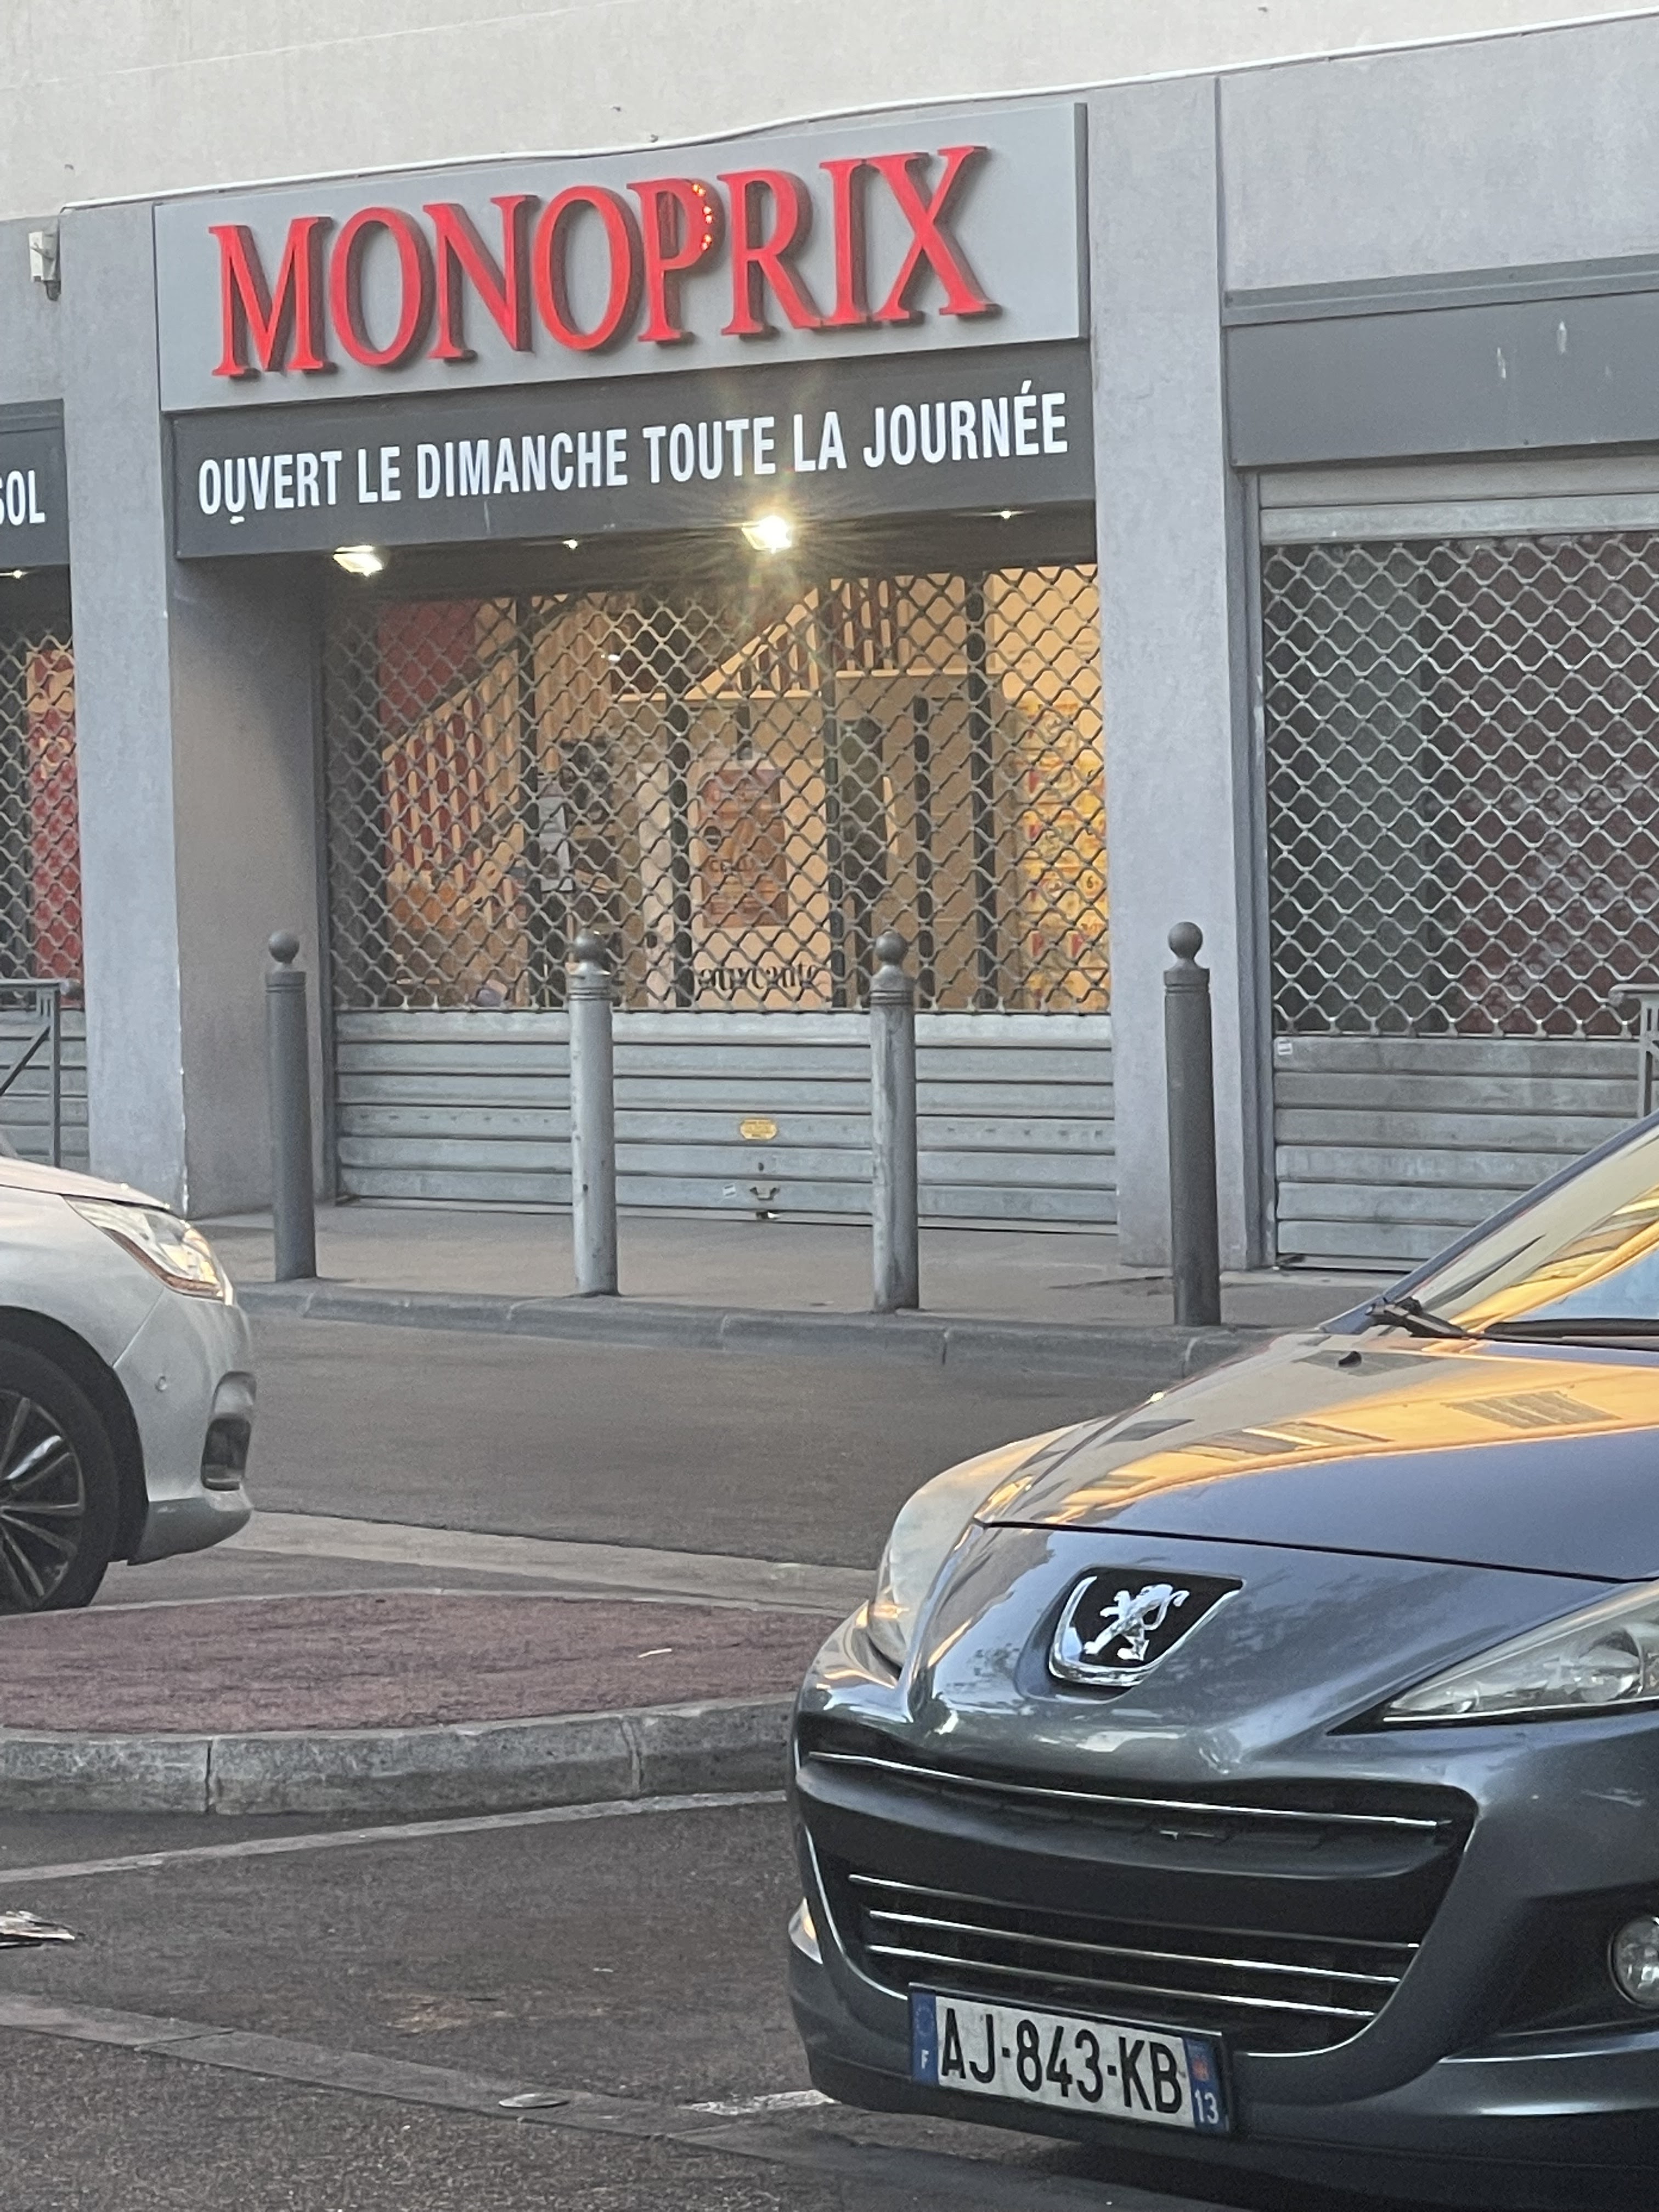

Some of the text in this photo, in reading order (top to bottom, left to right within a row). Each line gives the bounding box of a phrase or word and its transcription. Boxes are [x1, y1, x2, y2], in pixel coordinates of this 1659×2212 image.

[208, 145, 995, 377] MONOPRIX
[0, 470, 46, 526] OL
[199, 379, 1068, 515] OUVERT LE DIMANCHE TOUTE LA JOURNÉE
[921, 2007, 1218, 2124] F AJ-843-KB 13
